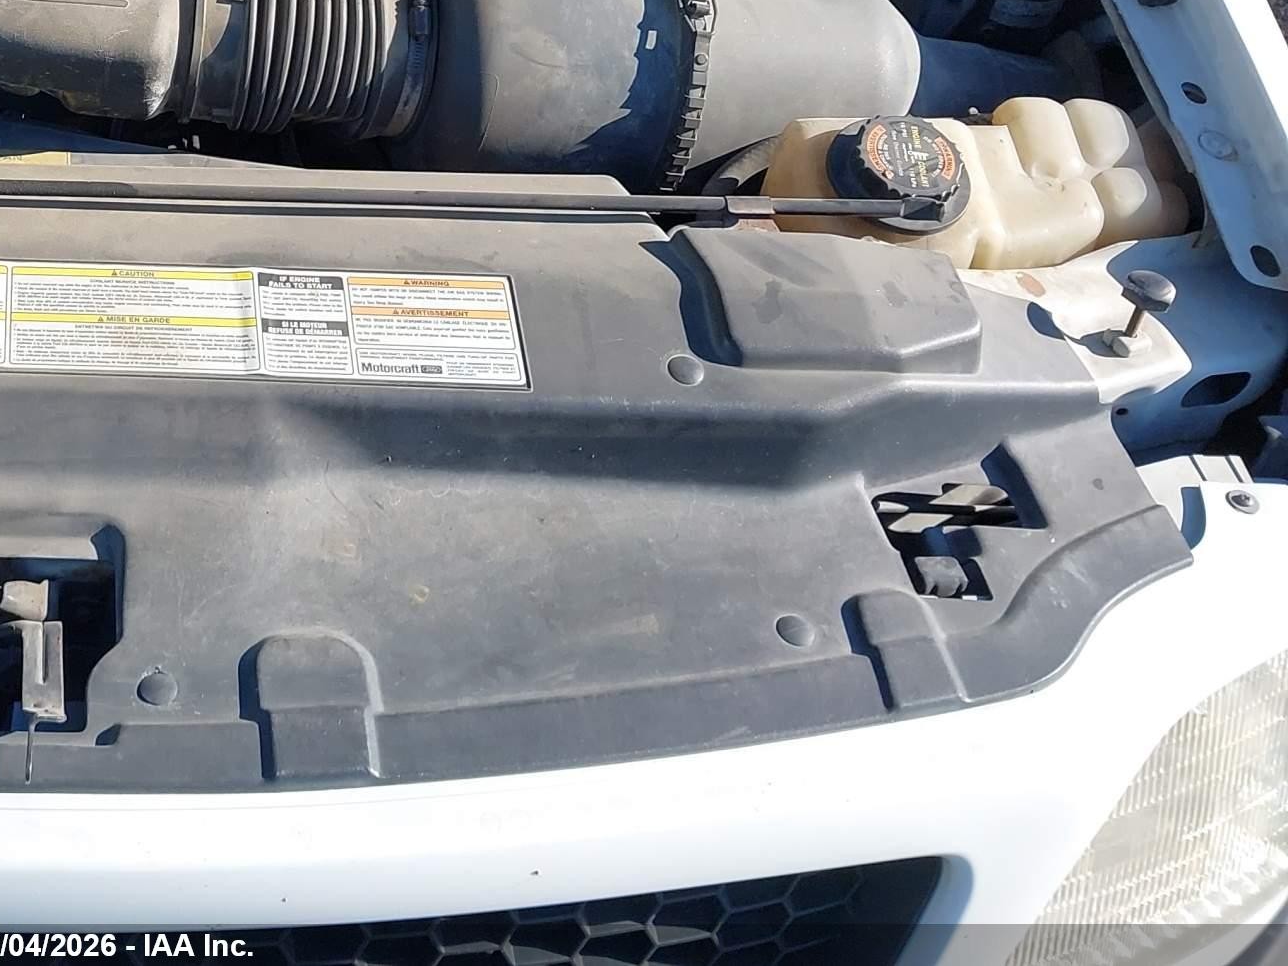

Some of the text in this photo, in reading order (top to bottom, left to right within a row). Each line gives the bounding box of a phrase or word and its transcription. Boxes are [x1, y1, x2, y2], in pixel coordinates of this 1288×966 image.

[910, 125, 930, 188] ENGINE COOLANT
[400, 308, 470, 317] AVERTISSEMENT
[361, 362, 420, 375] Motorcraft
